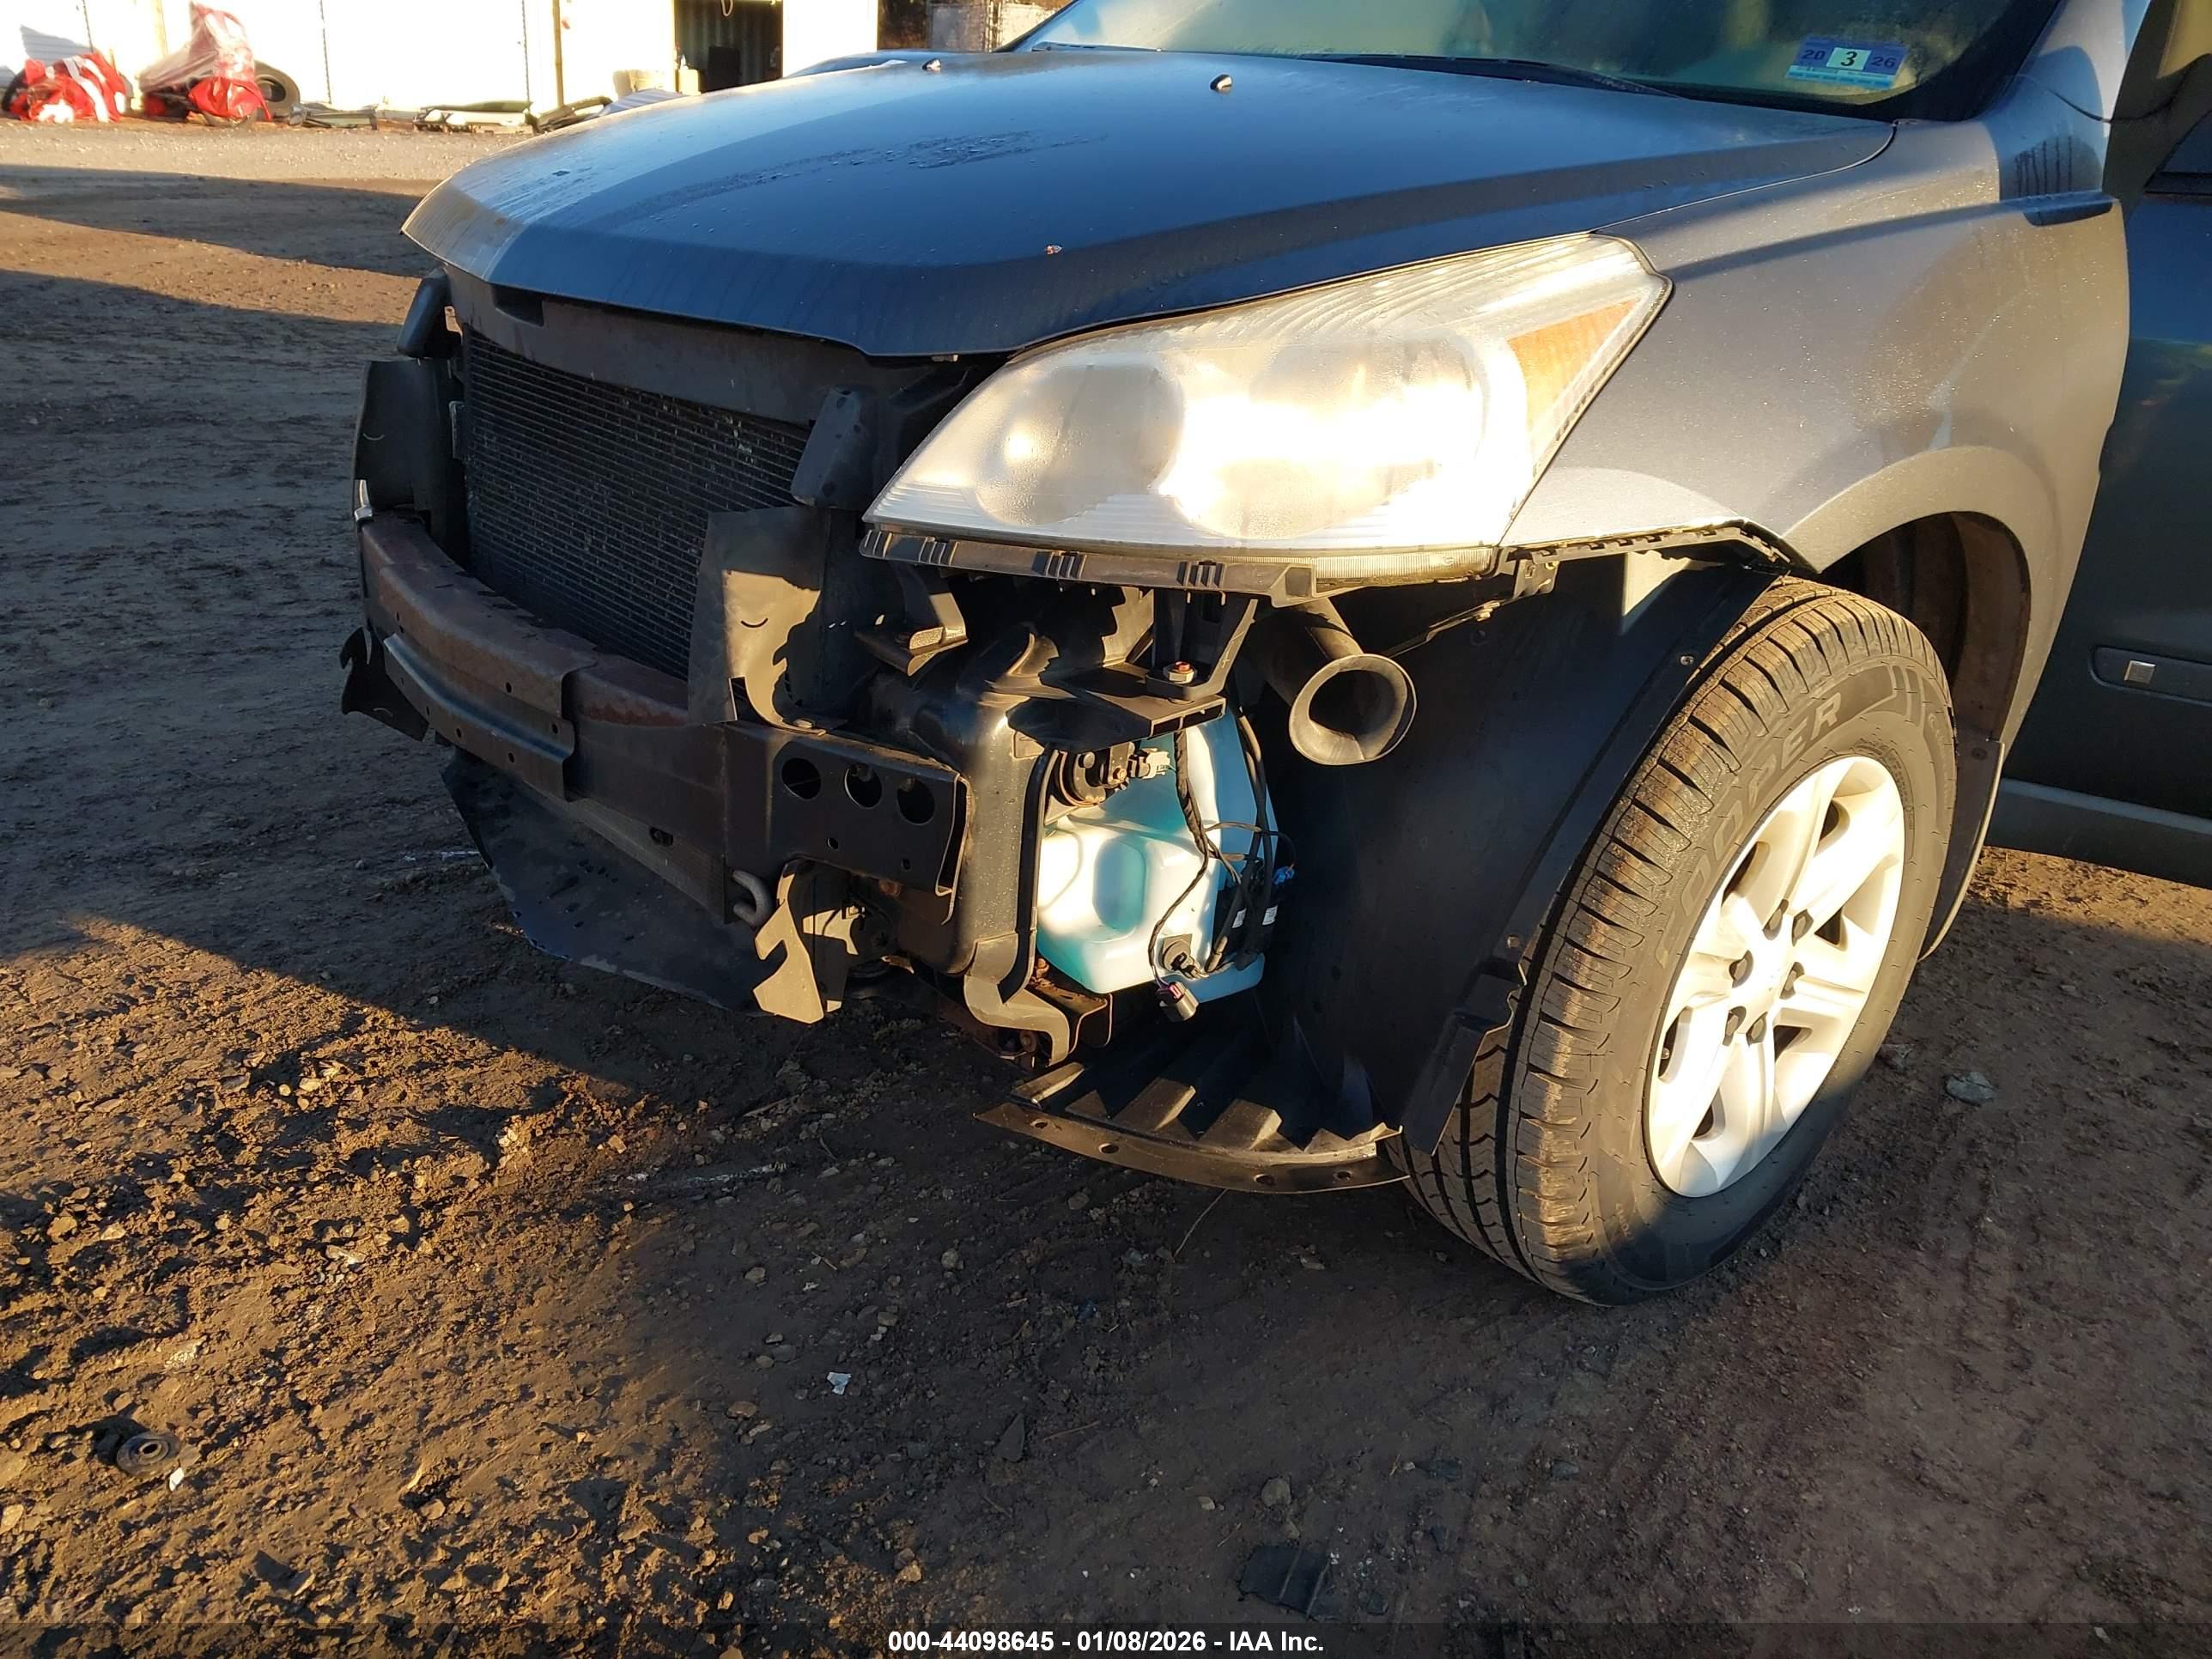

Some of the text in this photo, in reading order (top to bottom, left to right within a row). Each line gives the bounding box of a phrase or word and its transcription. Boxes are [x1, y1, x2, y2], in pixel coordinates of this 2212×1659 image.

[1802, 49, 1897, 69] 20 3 26
